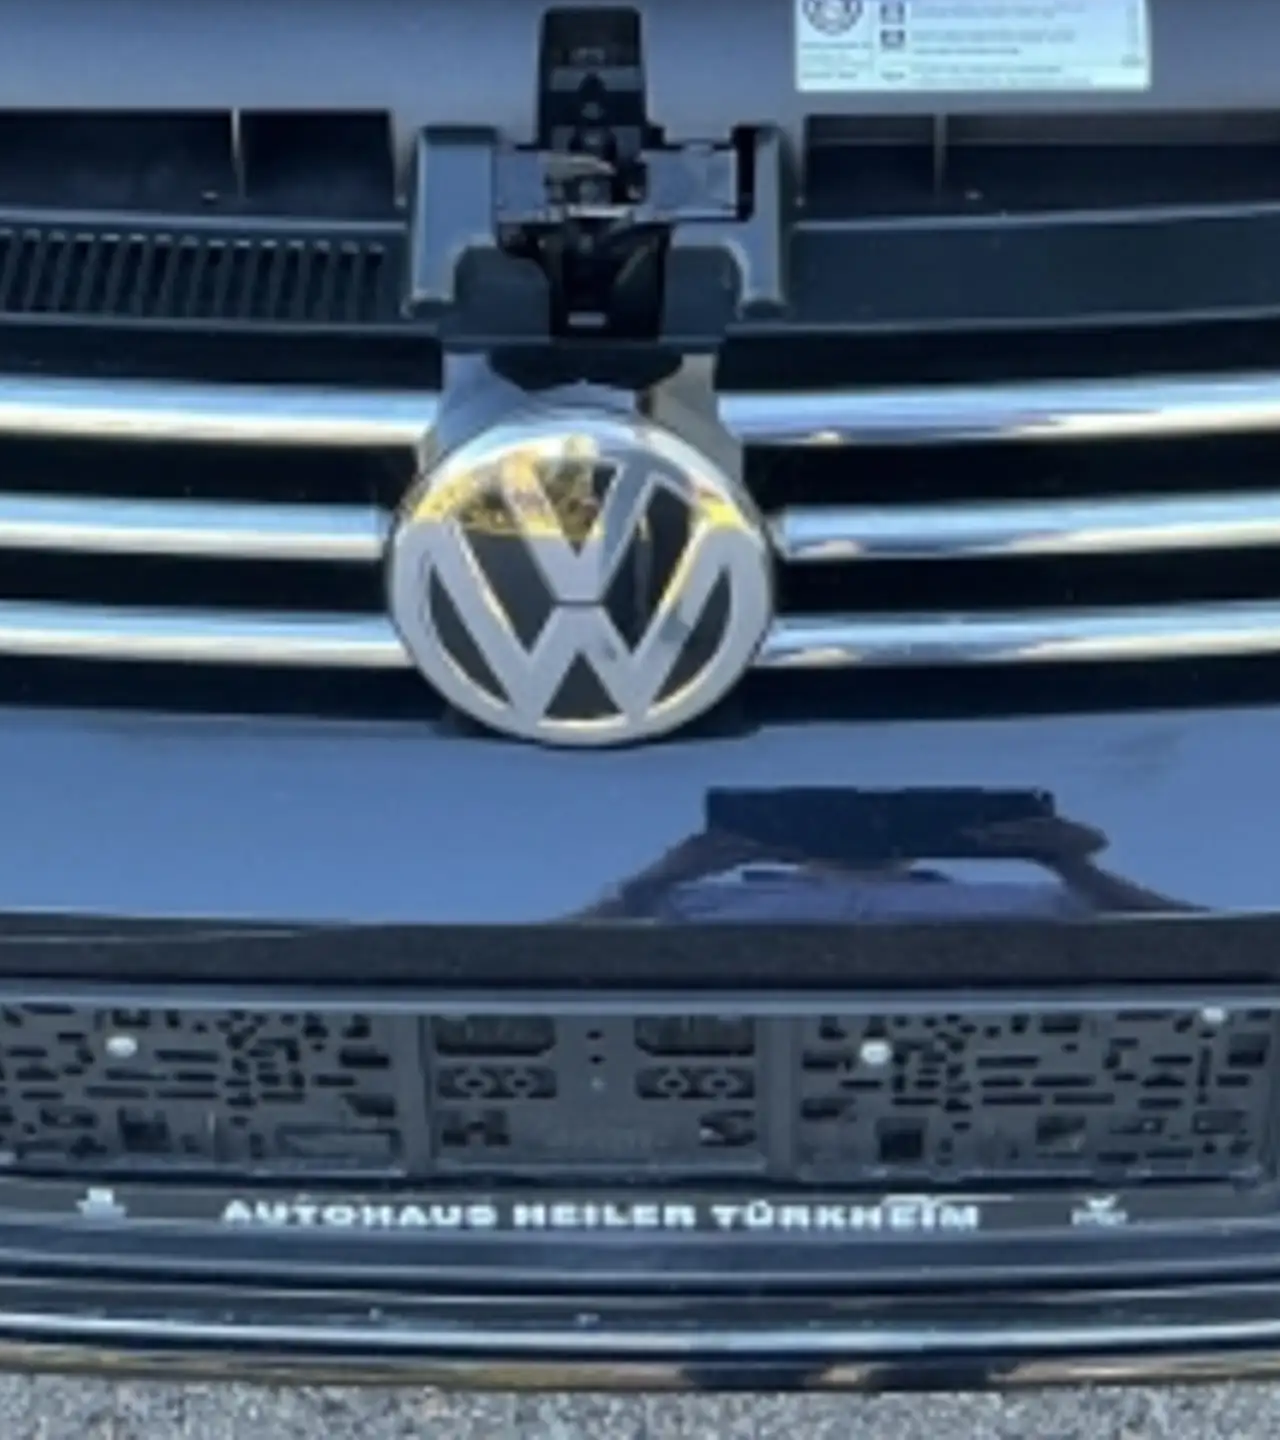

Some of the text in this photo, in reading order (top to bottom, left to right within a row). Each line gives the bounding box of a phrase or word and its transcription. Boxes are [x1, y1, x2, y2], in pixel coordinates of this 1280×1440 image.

[390, 420, 774, 746] VW
[223, 1198, 980, 1229] AUTOHAUS HEILER TÜRKHEIM
